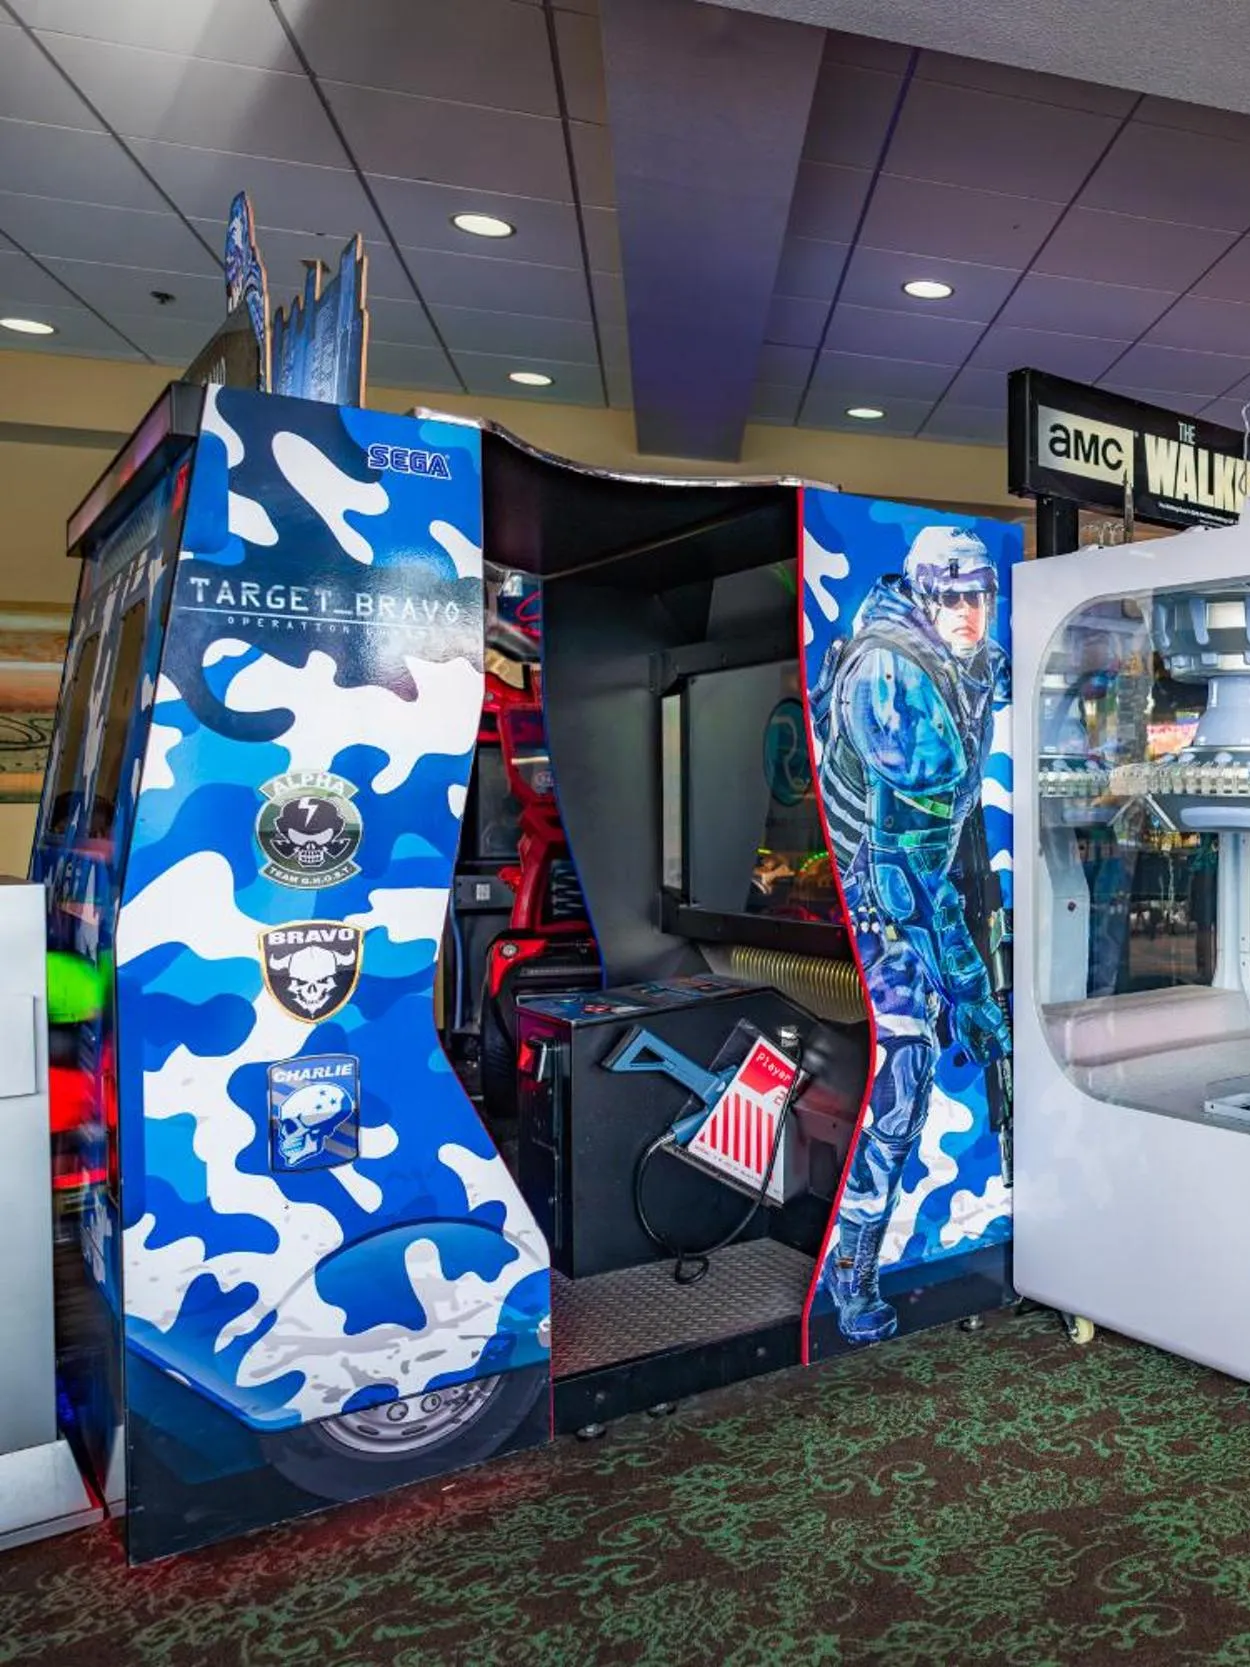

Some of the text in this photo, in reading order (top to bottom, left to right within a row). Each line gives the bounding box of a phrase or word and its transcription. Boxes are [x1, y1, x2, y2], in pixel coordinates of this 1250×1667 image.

[1178, 422, 1196, 445] THE
[368, 443, 452, 480] SEGA
[227, 616, 350, 634] OPERATION
[273, 772, 345, 795] ALPHA
[269, 866, 298, 883] TEAM
[268, 928, 355, 945] BRAVO
[272, 1063, 354, 1083] CHARLIE
[756, 1052, 791, 1082] Player
[773, 1090, 787, 1107] 2
